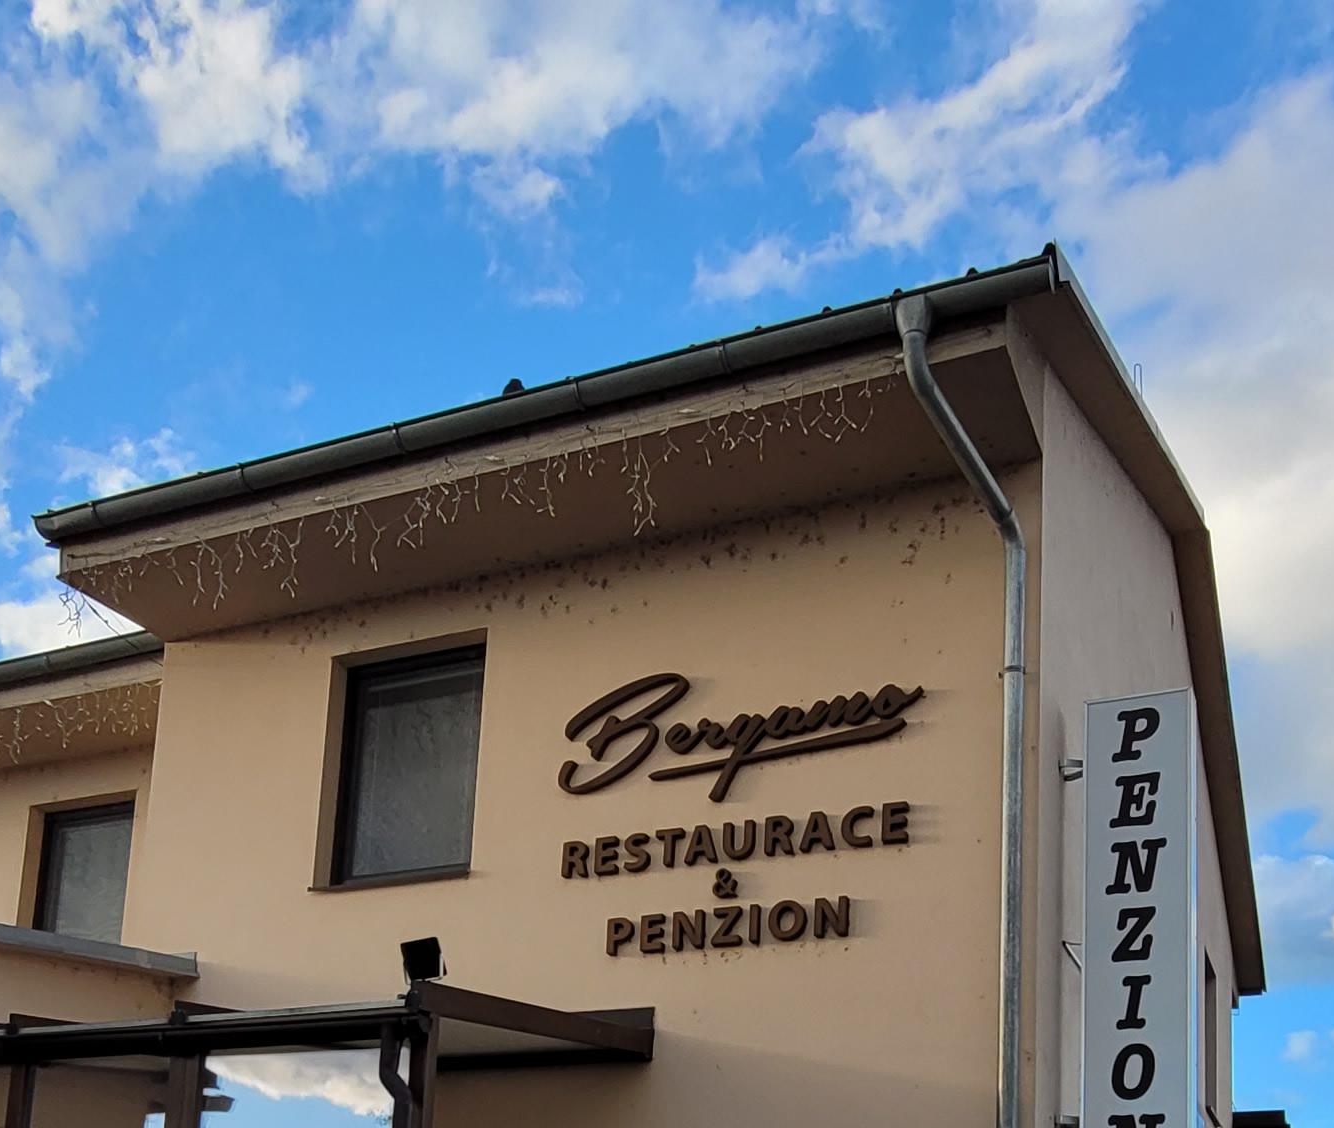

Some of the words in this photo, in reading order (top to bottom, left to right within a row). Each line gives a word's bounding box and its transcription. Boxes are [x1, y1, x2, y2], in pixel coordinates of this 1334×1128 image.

[558, 672, 924, 802] Bergamo
[561, 802, 910, 878] RESTAURACE
[712, 869, 739, 898] &
[605, 896, 851, 957] PENZION
